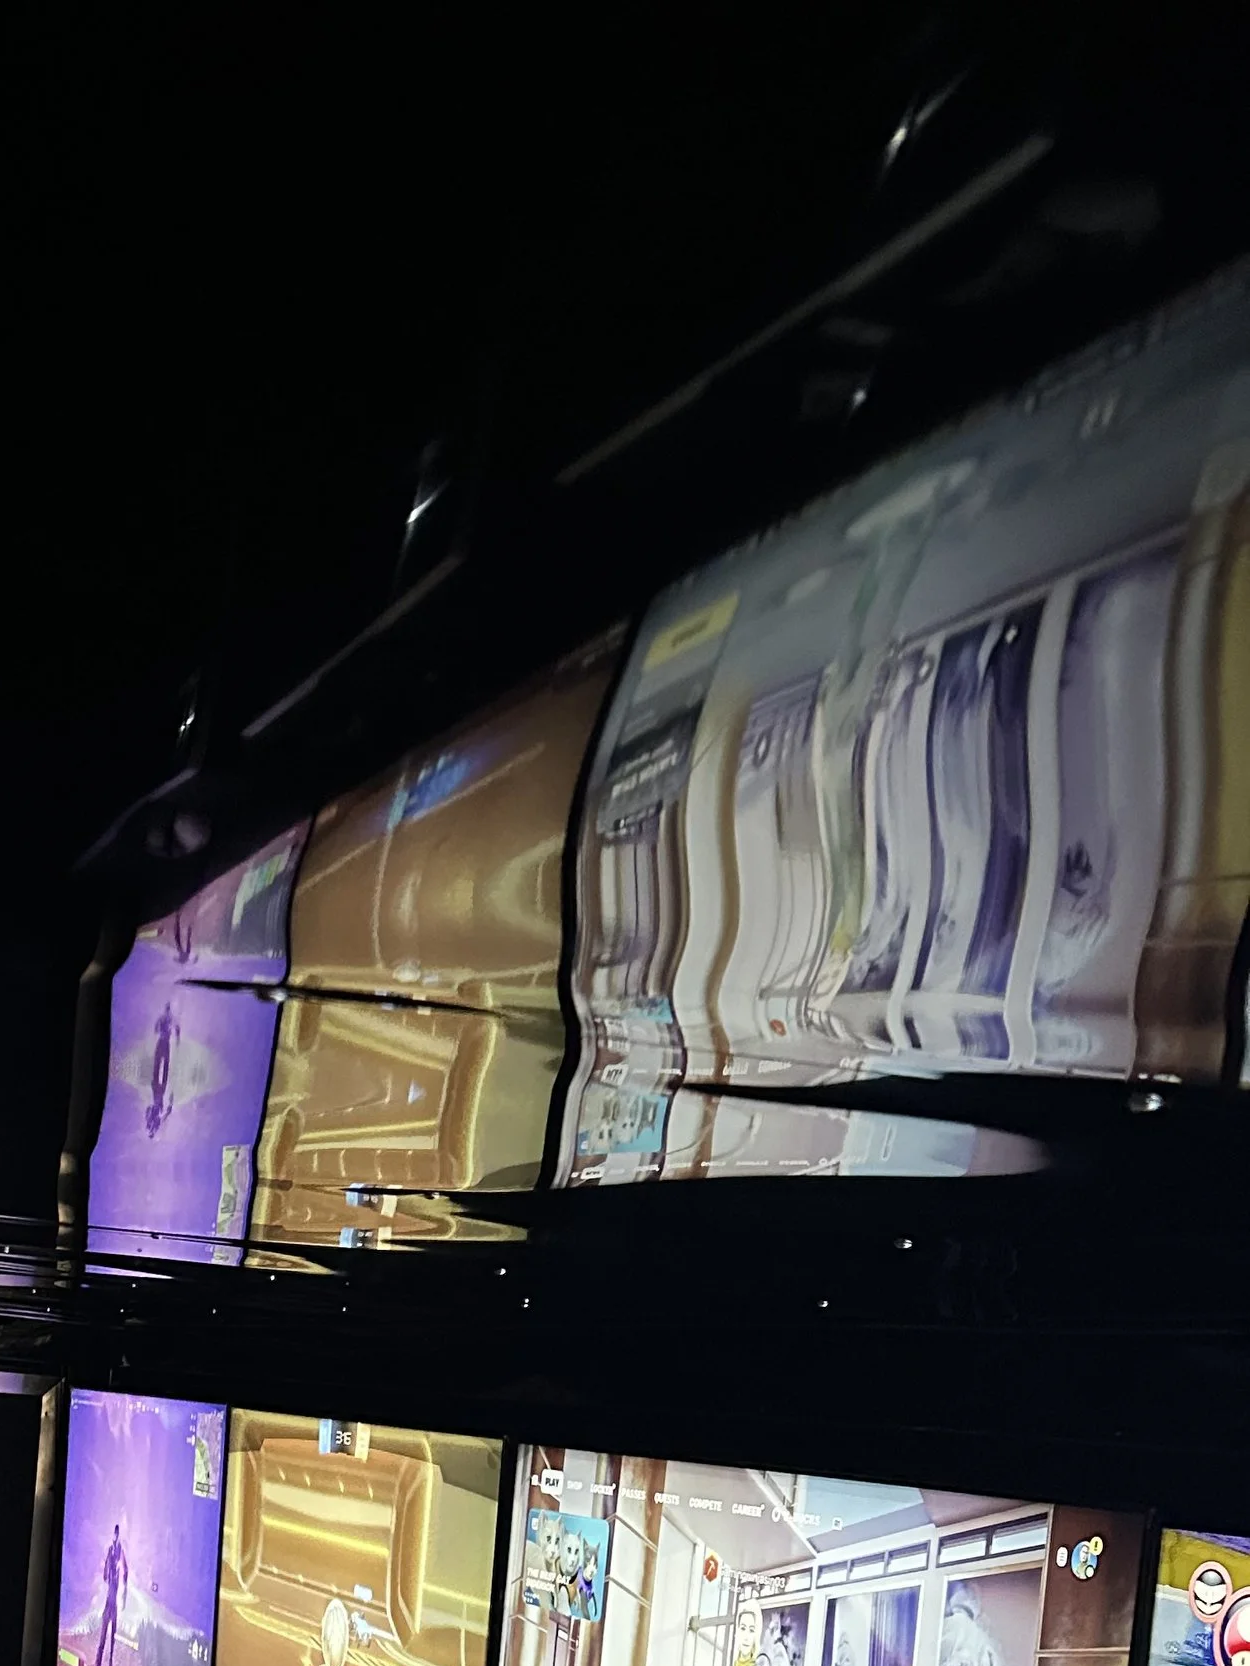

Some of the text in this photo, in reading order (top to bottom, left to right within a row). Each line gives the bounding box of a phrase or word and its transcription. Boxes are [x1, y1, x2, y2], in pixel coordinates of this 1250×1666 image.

[545, 1477, 559, 1487] PLAY
[621, 1488, 646, 1500] PASSES
[653, 1492, 680, 1505] QUESTS
[689, 1497, 723, 1512] COMPETE
[732, 1503, 762, 1518] CAREER
